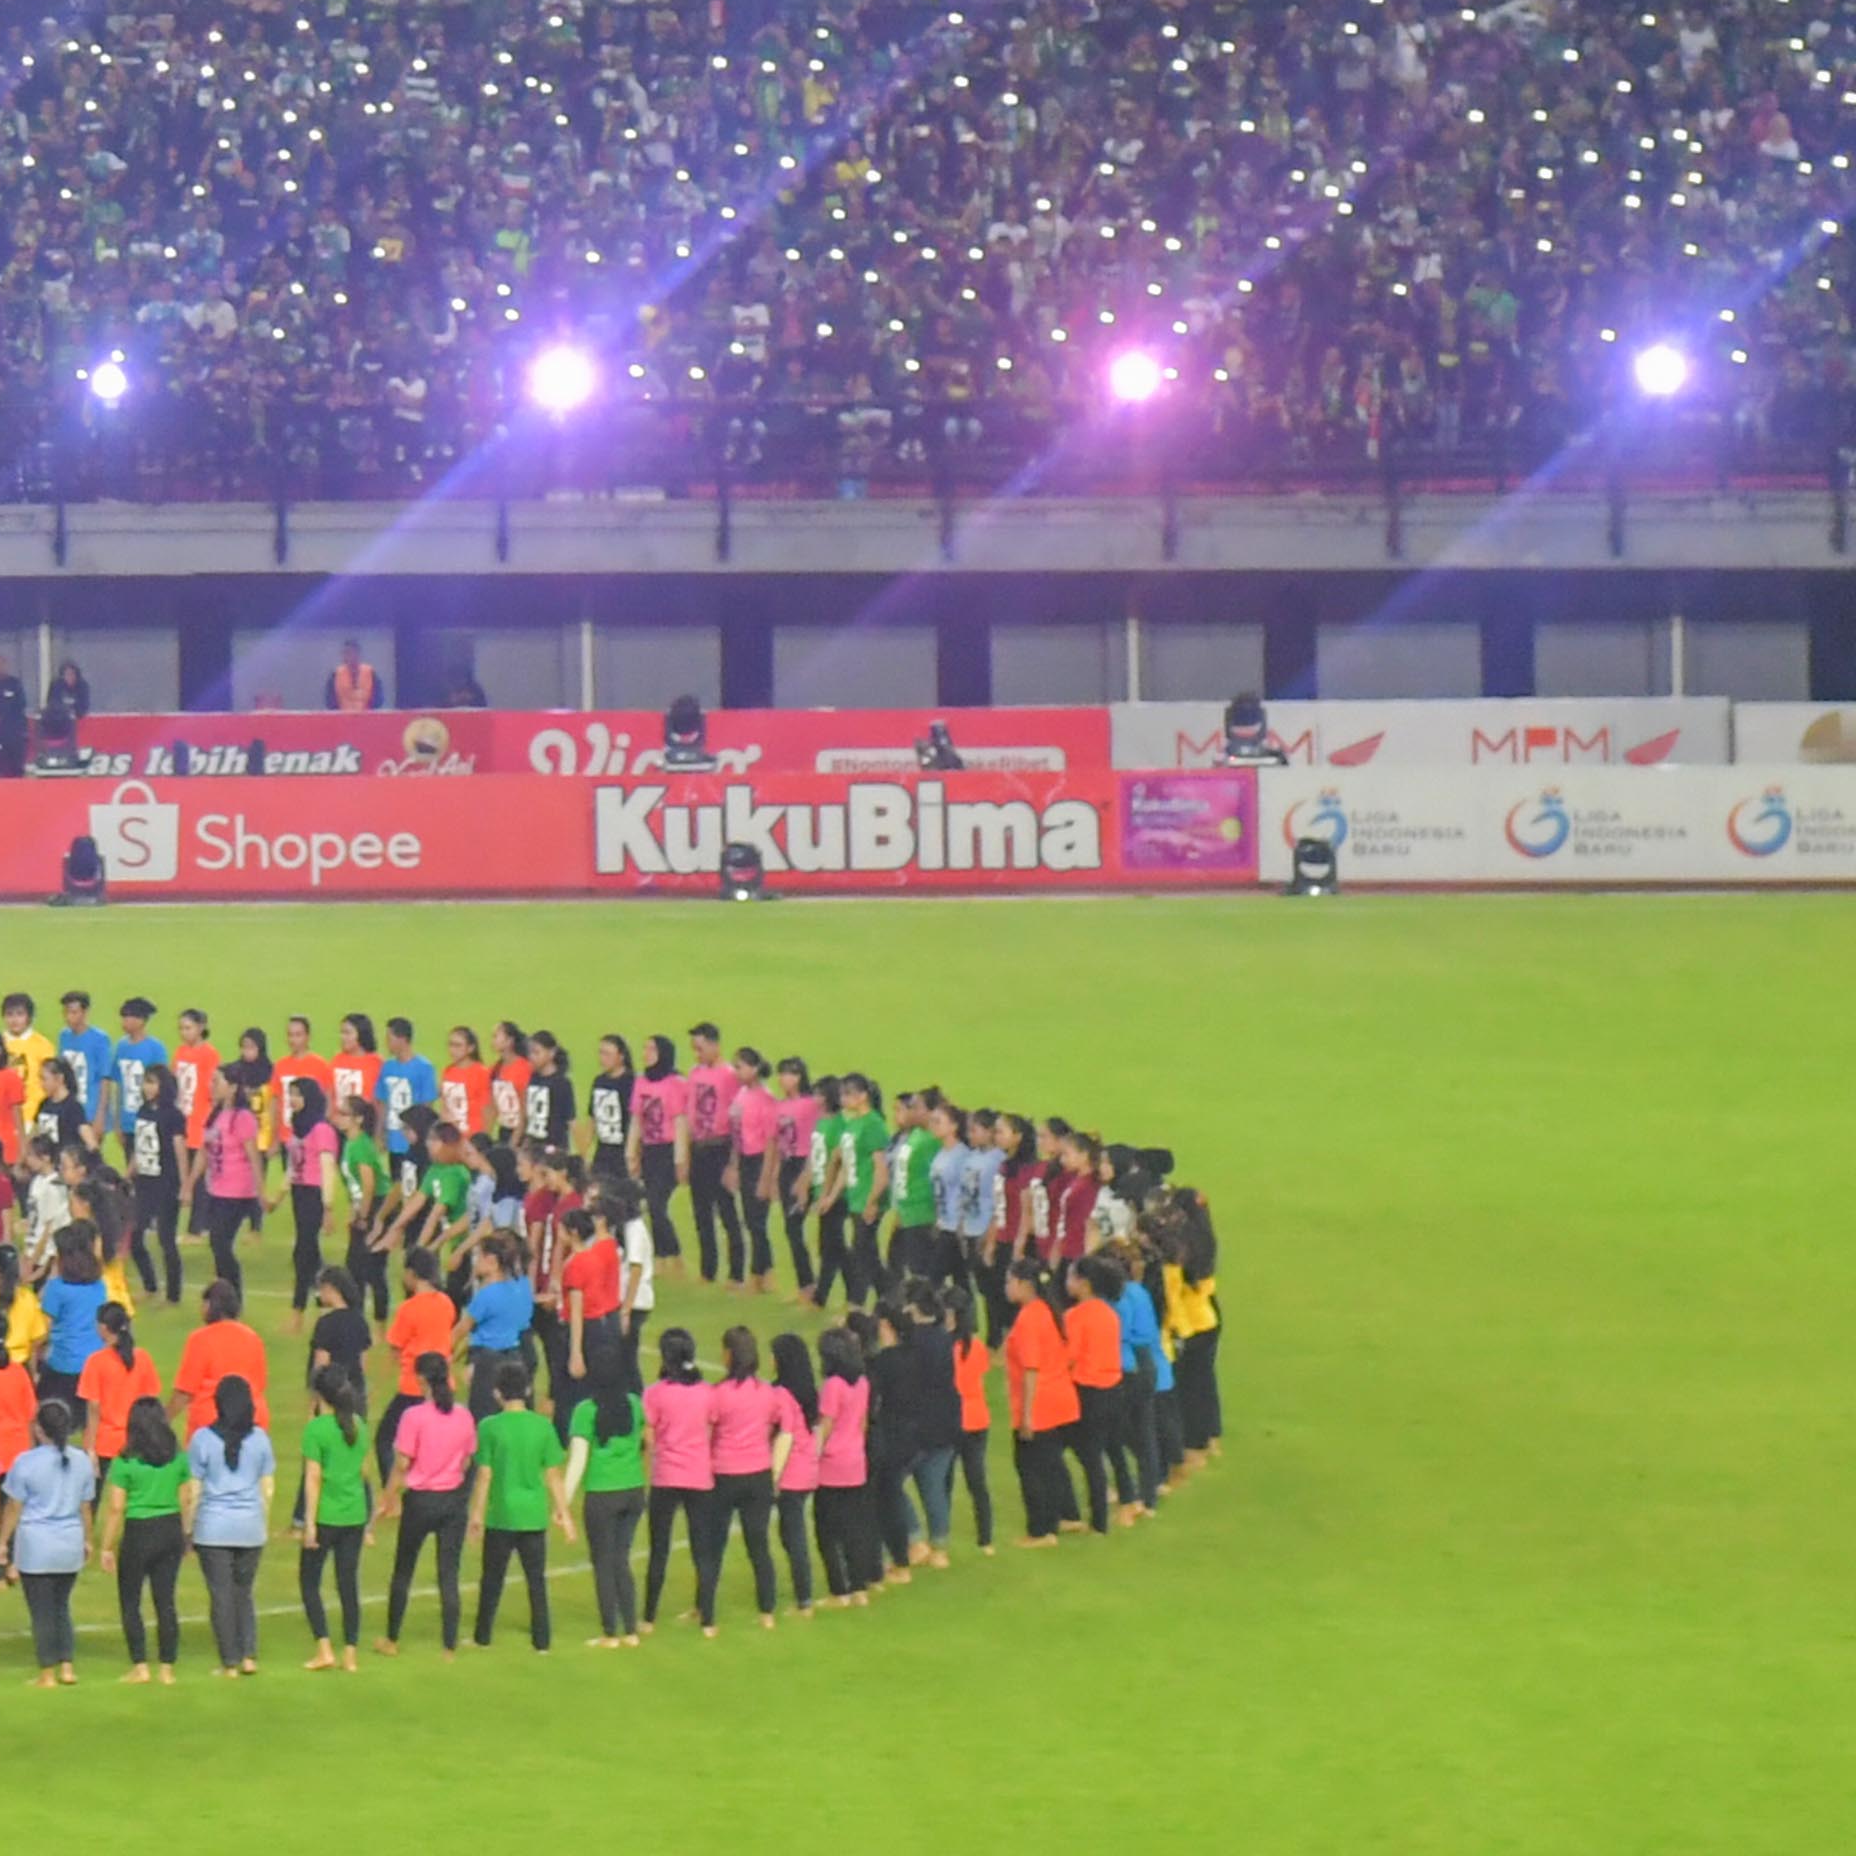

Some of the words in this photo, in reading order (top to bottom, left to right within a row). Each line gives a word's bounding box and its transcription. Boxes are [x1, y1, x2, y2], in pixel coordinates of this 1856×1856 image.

[264, 743, 361, 775] enak
[1177, 728, 1314, 766] MM
[195, 814, 421, 884] Shopee
[594, 780, 1104, 875] KukuBima
